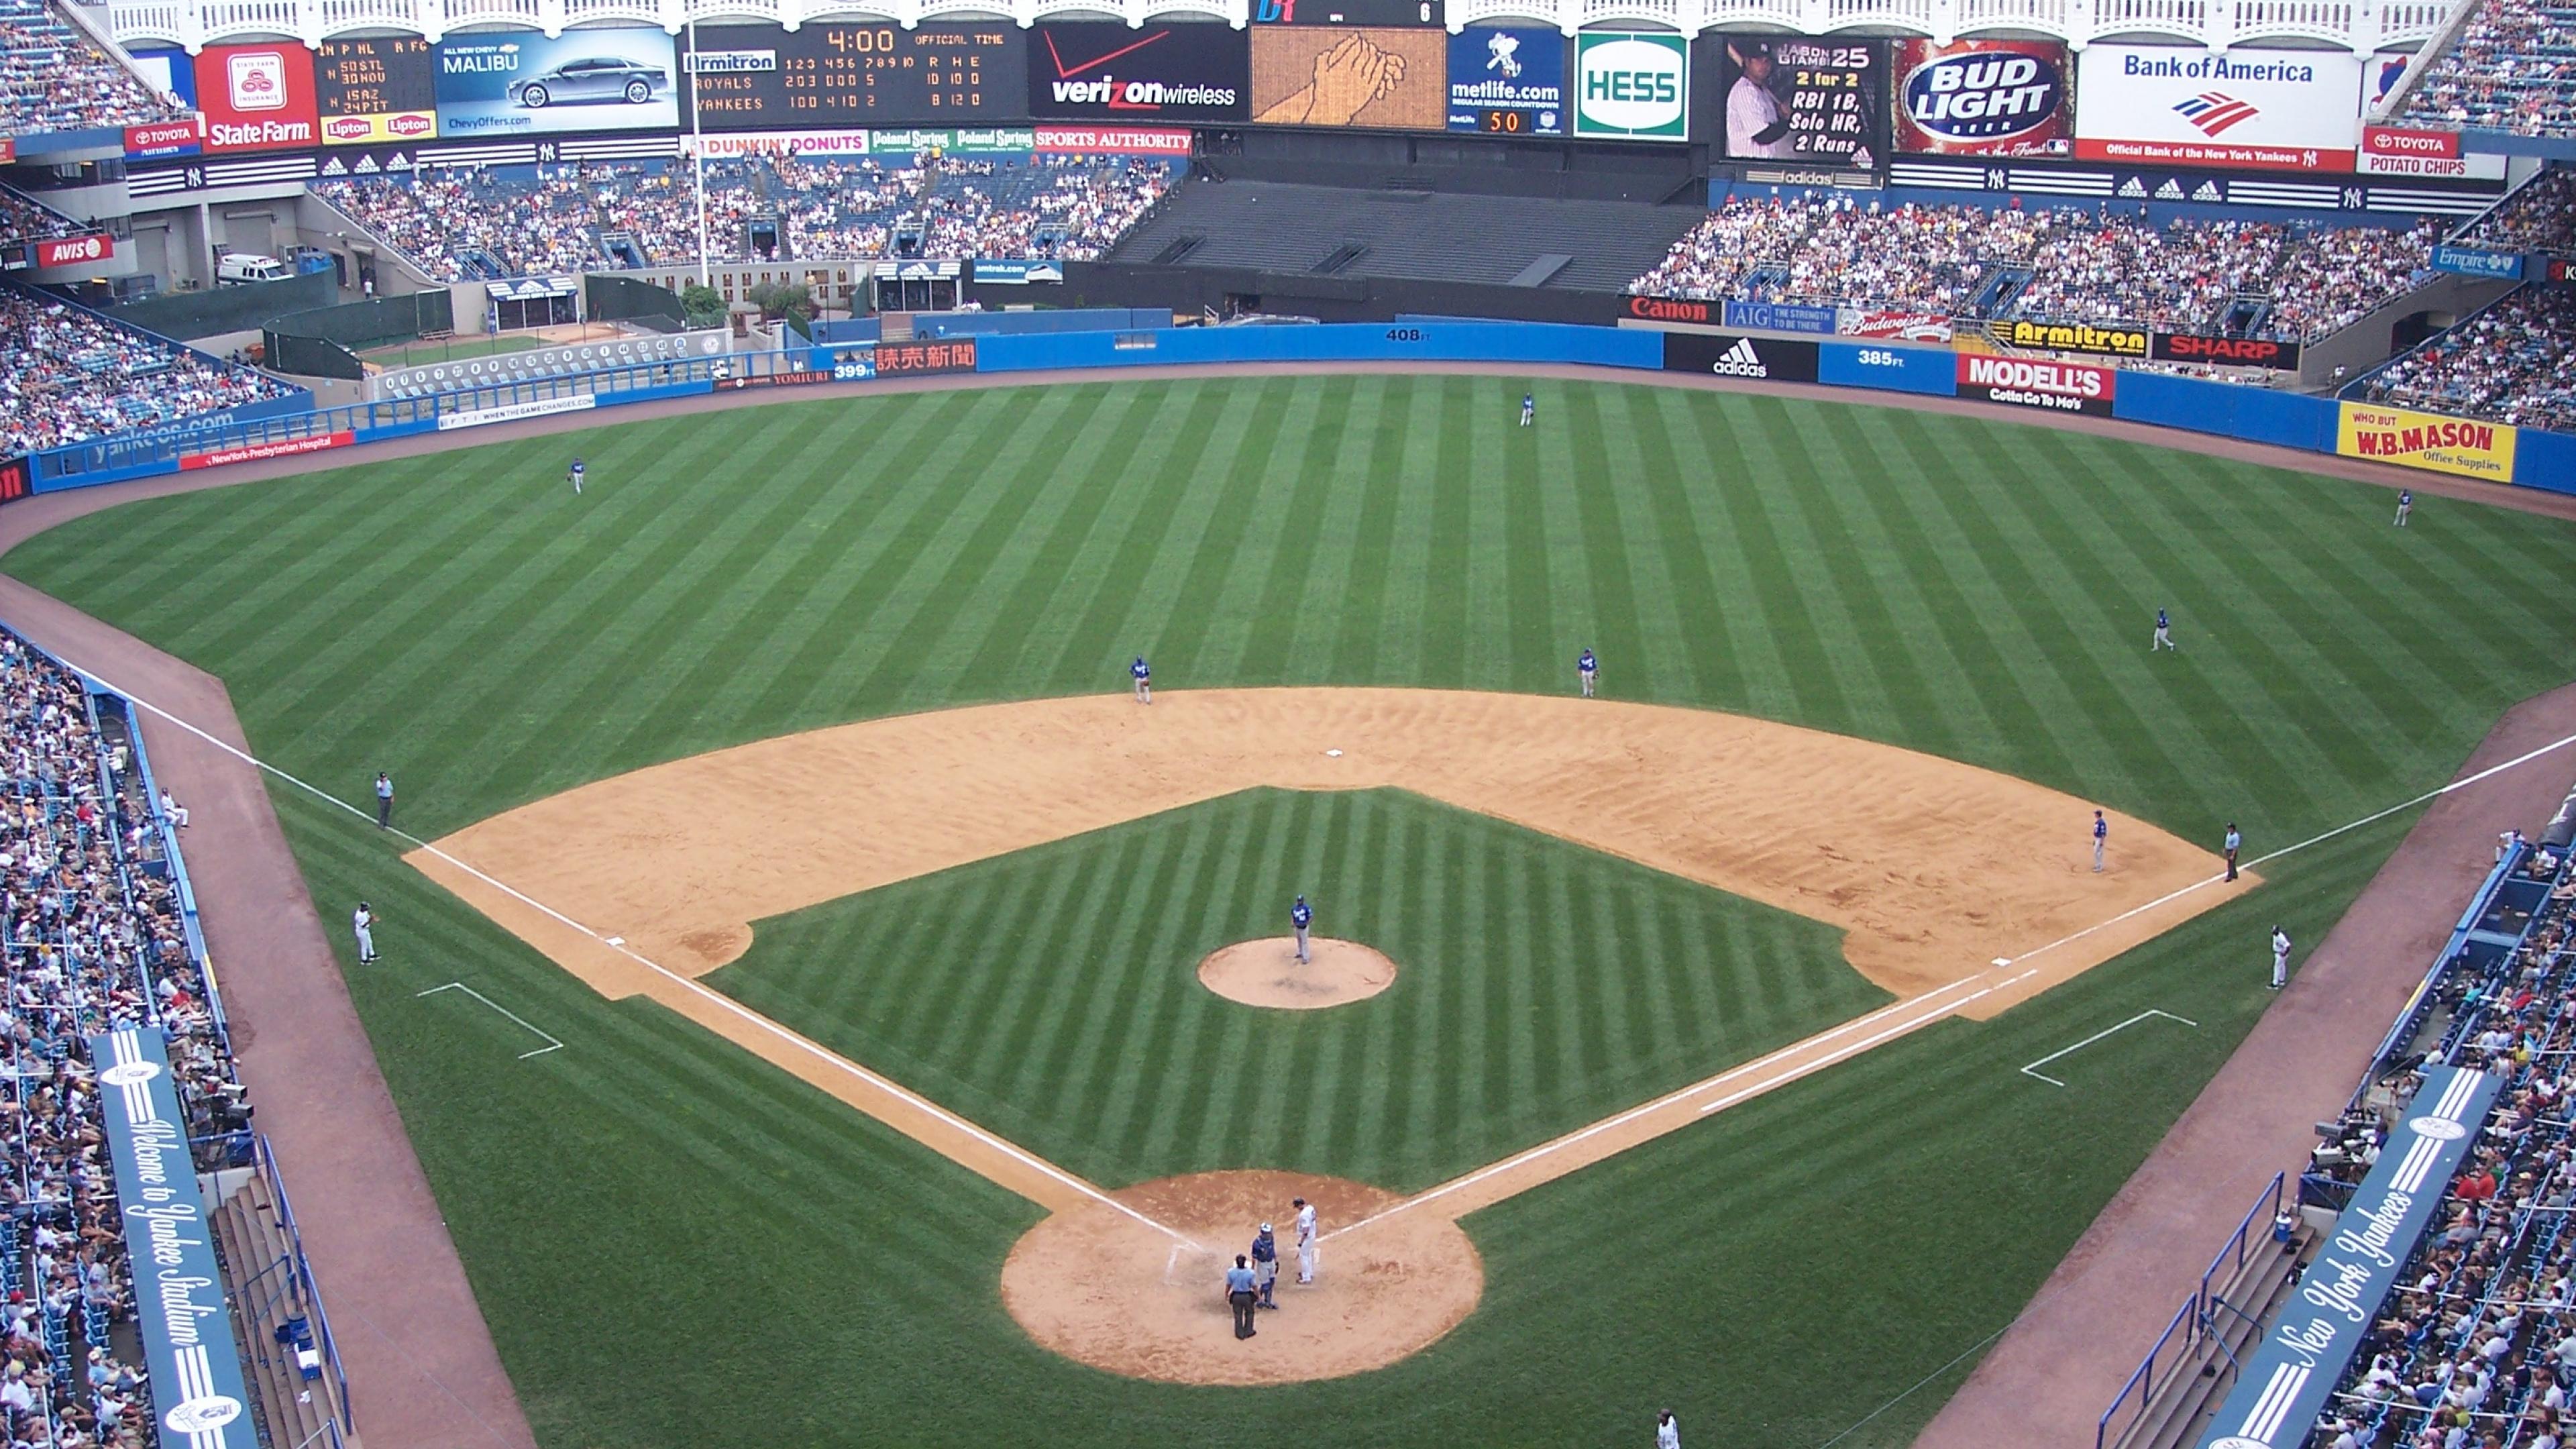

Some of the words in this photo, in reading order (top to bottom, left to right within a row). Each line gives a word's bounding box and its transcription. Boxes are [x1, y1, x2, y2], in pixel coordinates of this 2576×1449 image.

[1420, 3, 1430, 21] 6
[342, 44, 350, 56] P
[395, 42, 403, 54] R
[828, 31, 894, 52] 4:00
[915, 35, 967, 46] OFFICIAL
[975, 34, 1004, 45] TIME
[443, 55, 519, 74] MALIBU
[929, 57, 938, 67] R
[953, 56, 961, 67] H
[971, 56, 979, 67] E
[1778, 44, 1830, 56] JASON
[1831, 48, 1869, 68] 25
[1778, 55, 1830, 66] GIAMBI
[1930, 58, 2037, 92] BUD
[2125, 54, 2183, 77] Bank
[2186, 56, 2211, 78] of
[2214, 58, 2312, 83] America
[696, 77, 752, 90] ROYALS
[928, 73, 939, 85] 10
[951, 73, 961, 85] 10
[971, 73, 979, 85] 0
[1587, 70, 1676, 103] HESS
[1796, 72, 1809, 85] 2
[1815, 72, 1839, 87] for
[1845, 73, 1858, 87] 2
[1452, 80, 1559, 100] metlife.com
[362, 101, 388, 112] PIT
[697, 98, 763, 111] YANKEES
[932, 94, 939, 105] 8
[951, 94, 963, 105] 12
[971, 93, 979, 105] 0
[1452, 98, 1483, 106] REGULAR
[1484, 99, 1509, 107] SEASON
[1511, 101, 1559, 109] COUNTDOWN
[1792, 91, 1825, 109] RBI
[1833, 93, 1859, 112] 1B,
[1915, 83, 2051, 120] LIGHT
[329, 123, 370, 137] Lipton
[390, 119, 429, 133] Lipton
[449, 117, 531, 129] ChevyOffers.com
[1789, 112, 1824, 130] Solo
[1831, 113, 1861, 134] HR,
[1952, 122, 2010, 133] BEER
[151, 128, 191, 142] TOYOTA
[873, 131, 910, 148] Poland
[912, 131, 950, 148] Spring
[957, 129, 995, 147] Poland
[996, 129, 1034, 147] Spring
[1036, 132, 1095, 147] SPORTS
[1099, 133, 1191, 149] AUTHORITY
[1795, 136, 1809, 151] 2
[1813, 135, 1856, 152] Runs
[2394, 136, 2444, 152] TOYOTA
[709, 138, 785, 153] DUNKIN'
[791, 136, 862, 151] DONUTS
[2106, 144, 2143, 156] Official
[2144, 146, 2171, 158] Bank
[2173, 148, 2184, 158] of
[2186, 148, 2202, 159] the
[2204, 149, 2226, 160] New
[2229, 150, 2252, 161] York
[2255, 151, 2297, 163] Yankees
[2370, 157, 2420, 172] POTATO
[2424, 160, 2465, 175] CHIPS
[1785, 171, 1831, 184] adidas
[53, 241, 85, 262] AVIS
[2439, 248, 2486, 272] Empire
[976, 264, 1025, 272] amtrak.com
[1631, 297, 1707, 321] Canon
[1734, 307, 1768, 326] AIG
[1775, 309, 1789, 318] THE
[1790, 310, 1830, 321] STRENGTH
[1774, 319, 1785, 327] TO
[1788, 320, 1797, 329] BE
[1798, 321, 1823, 331] THERE.
[1843, 314, 1931, 335] Budweiser
[2015, 322, 2145, 347] Armitron
[2169, 335, 2278, 359] SHARP
[876, 343, 975, 371] 読売新聞
[774, 371, 828, 384] YOMIURI
[1713, 361, 1767, 378] adidas
[1970, 358, 2101, 396] MODELL'S
[1990, 388, 2023, 402] Gotta
[2024, 391, 2039, 405] Go
[2040, 394, 2054, 407] To
[2056, 396, 2082, 410] Mo's
[2353, 413, 2375, 424] WHO
[2378, 413, 2397, 426] BUT
[299, 437, 331, 451] Hospital
[2423, 450, 2453, 464] Office
[2456, 455, 2501, 472] Supplies
[130, 1119, 180, 1185] Welcome
[141, 1187, 176, 1202] to
[125, 1203, 202, 1265] Yankee
[2335, 1190, 2412, 1267] Yankees
[2303, 1256, 2371, 1322] York
[158, 1269, 217, 1346] Stadium
[2276, 1318, 2337, 1368] New
